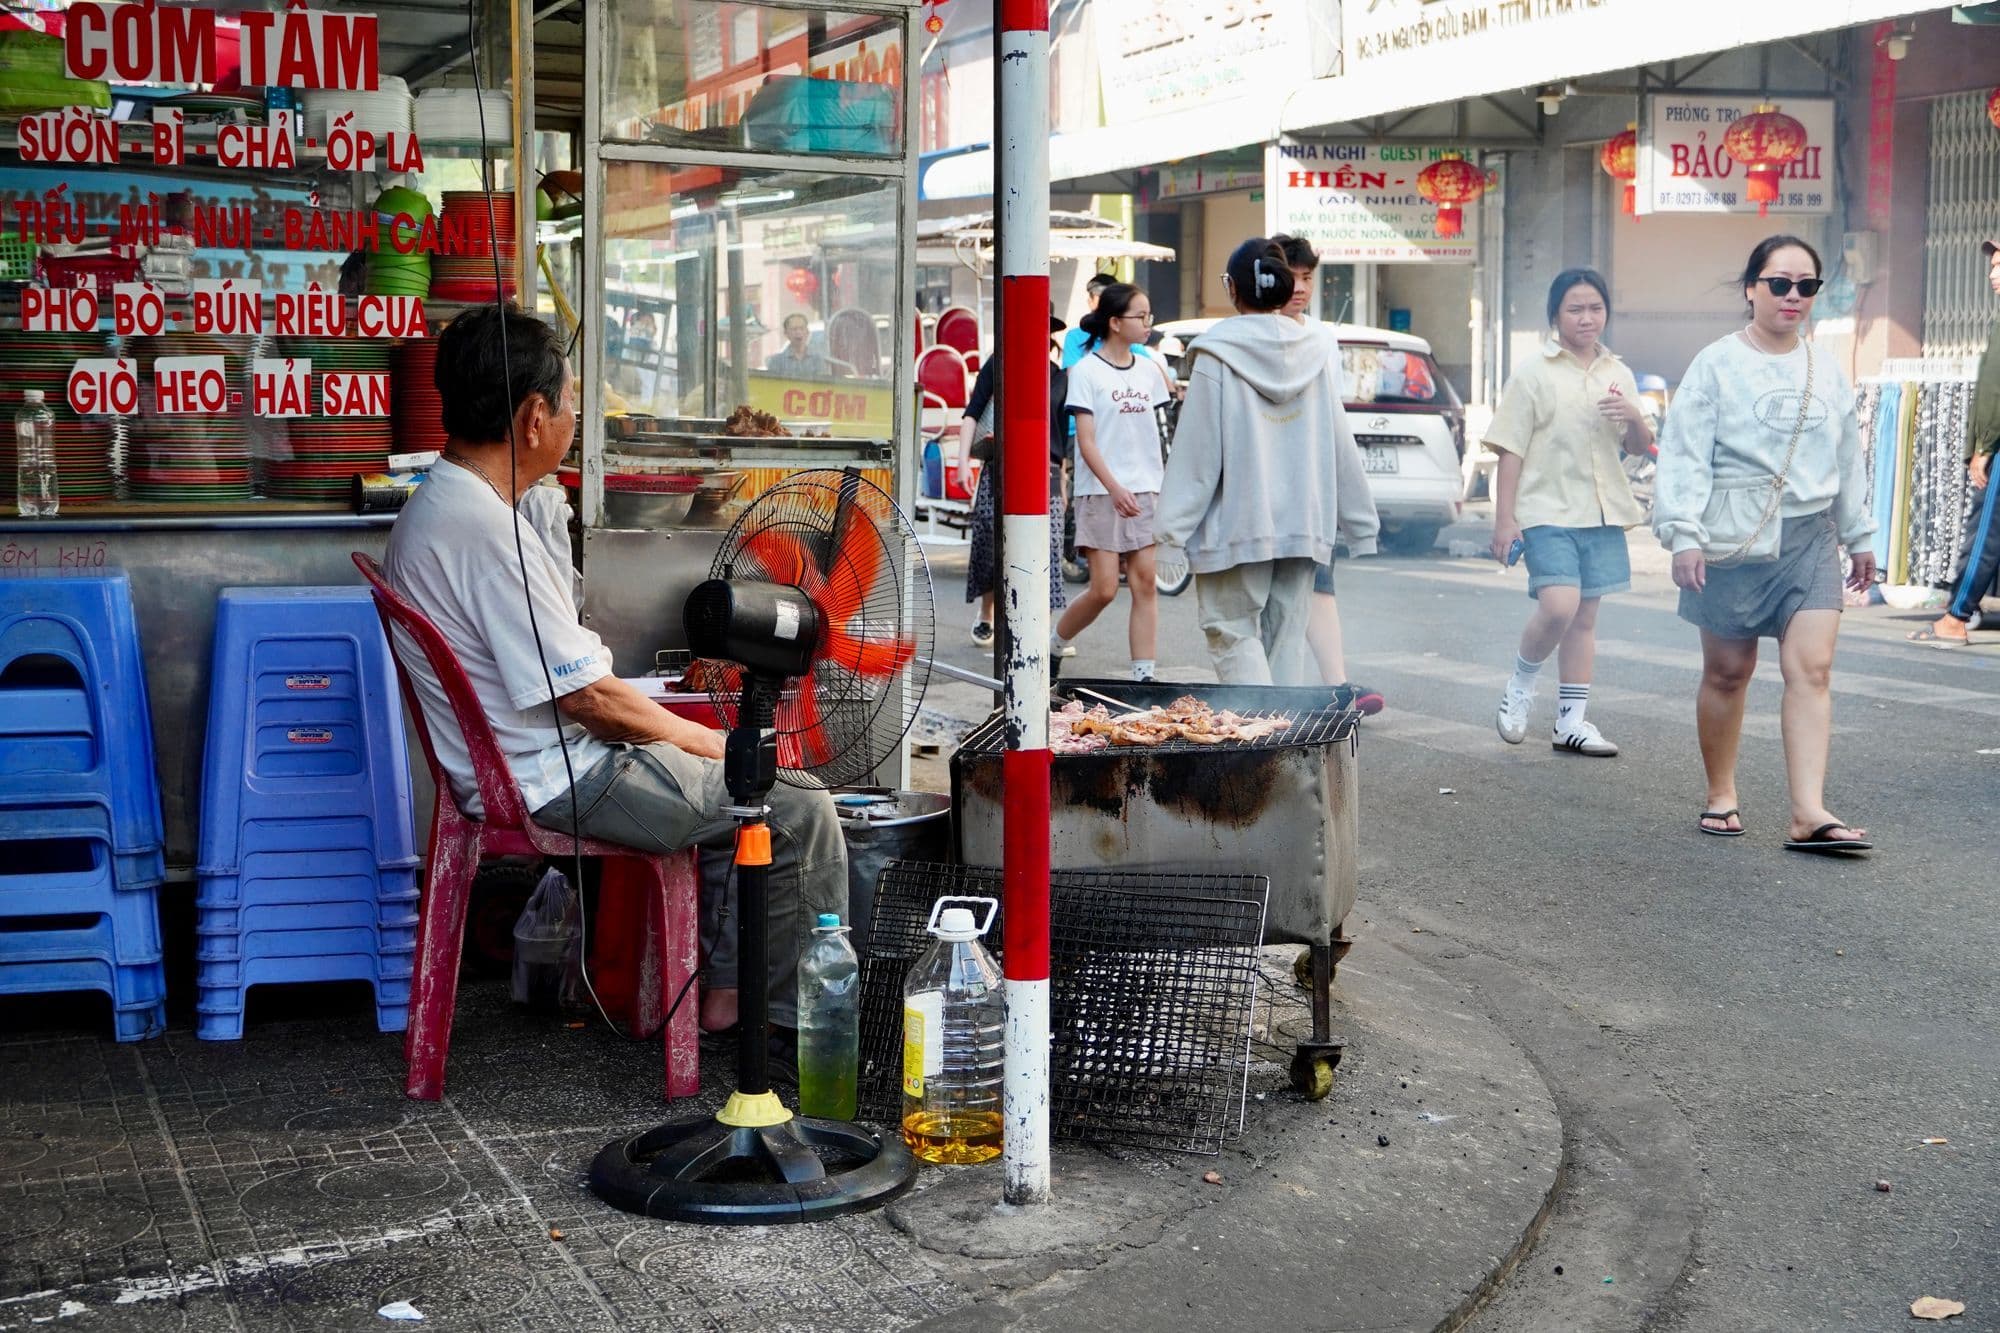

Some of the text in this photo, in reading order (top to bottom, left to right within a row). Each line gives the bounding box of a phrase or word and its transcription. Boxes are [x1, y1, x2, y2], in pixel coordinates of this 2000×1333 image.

[66, 0, 216, 83] CƠM
[1666, 103, 1709, 121] PHÒNG
[19, 106, 424, 173] SƯỜN BÌ CHẢ ỐP LA
[1380, 145, 1423, 161] GUEST
[1429, 145, 1473, 161] HOSE
[1671, 131, 1732, 179] BẢO
[1288, 163, 1387, 189] HIỀN
[14, 182, 86, 245] TIẾU
[120, 191, 160, 247] MÌ
[195, 206, 252, 249] NUI
[390, 211, 489, 256] CANH
[115, 282, 164, 336] BÒ
[194, 279, 262, 334] BÚN
[276, 282, 346, 337] RIÊU
[359, 294, 428, 338] CUA
[69, 358, 390, 417] GIÒ HEO HẢI SAN
[783, 389, 867, 421] CƠM
[0, 541, 107, 567] ÔM KHÔ
